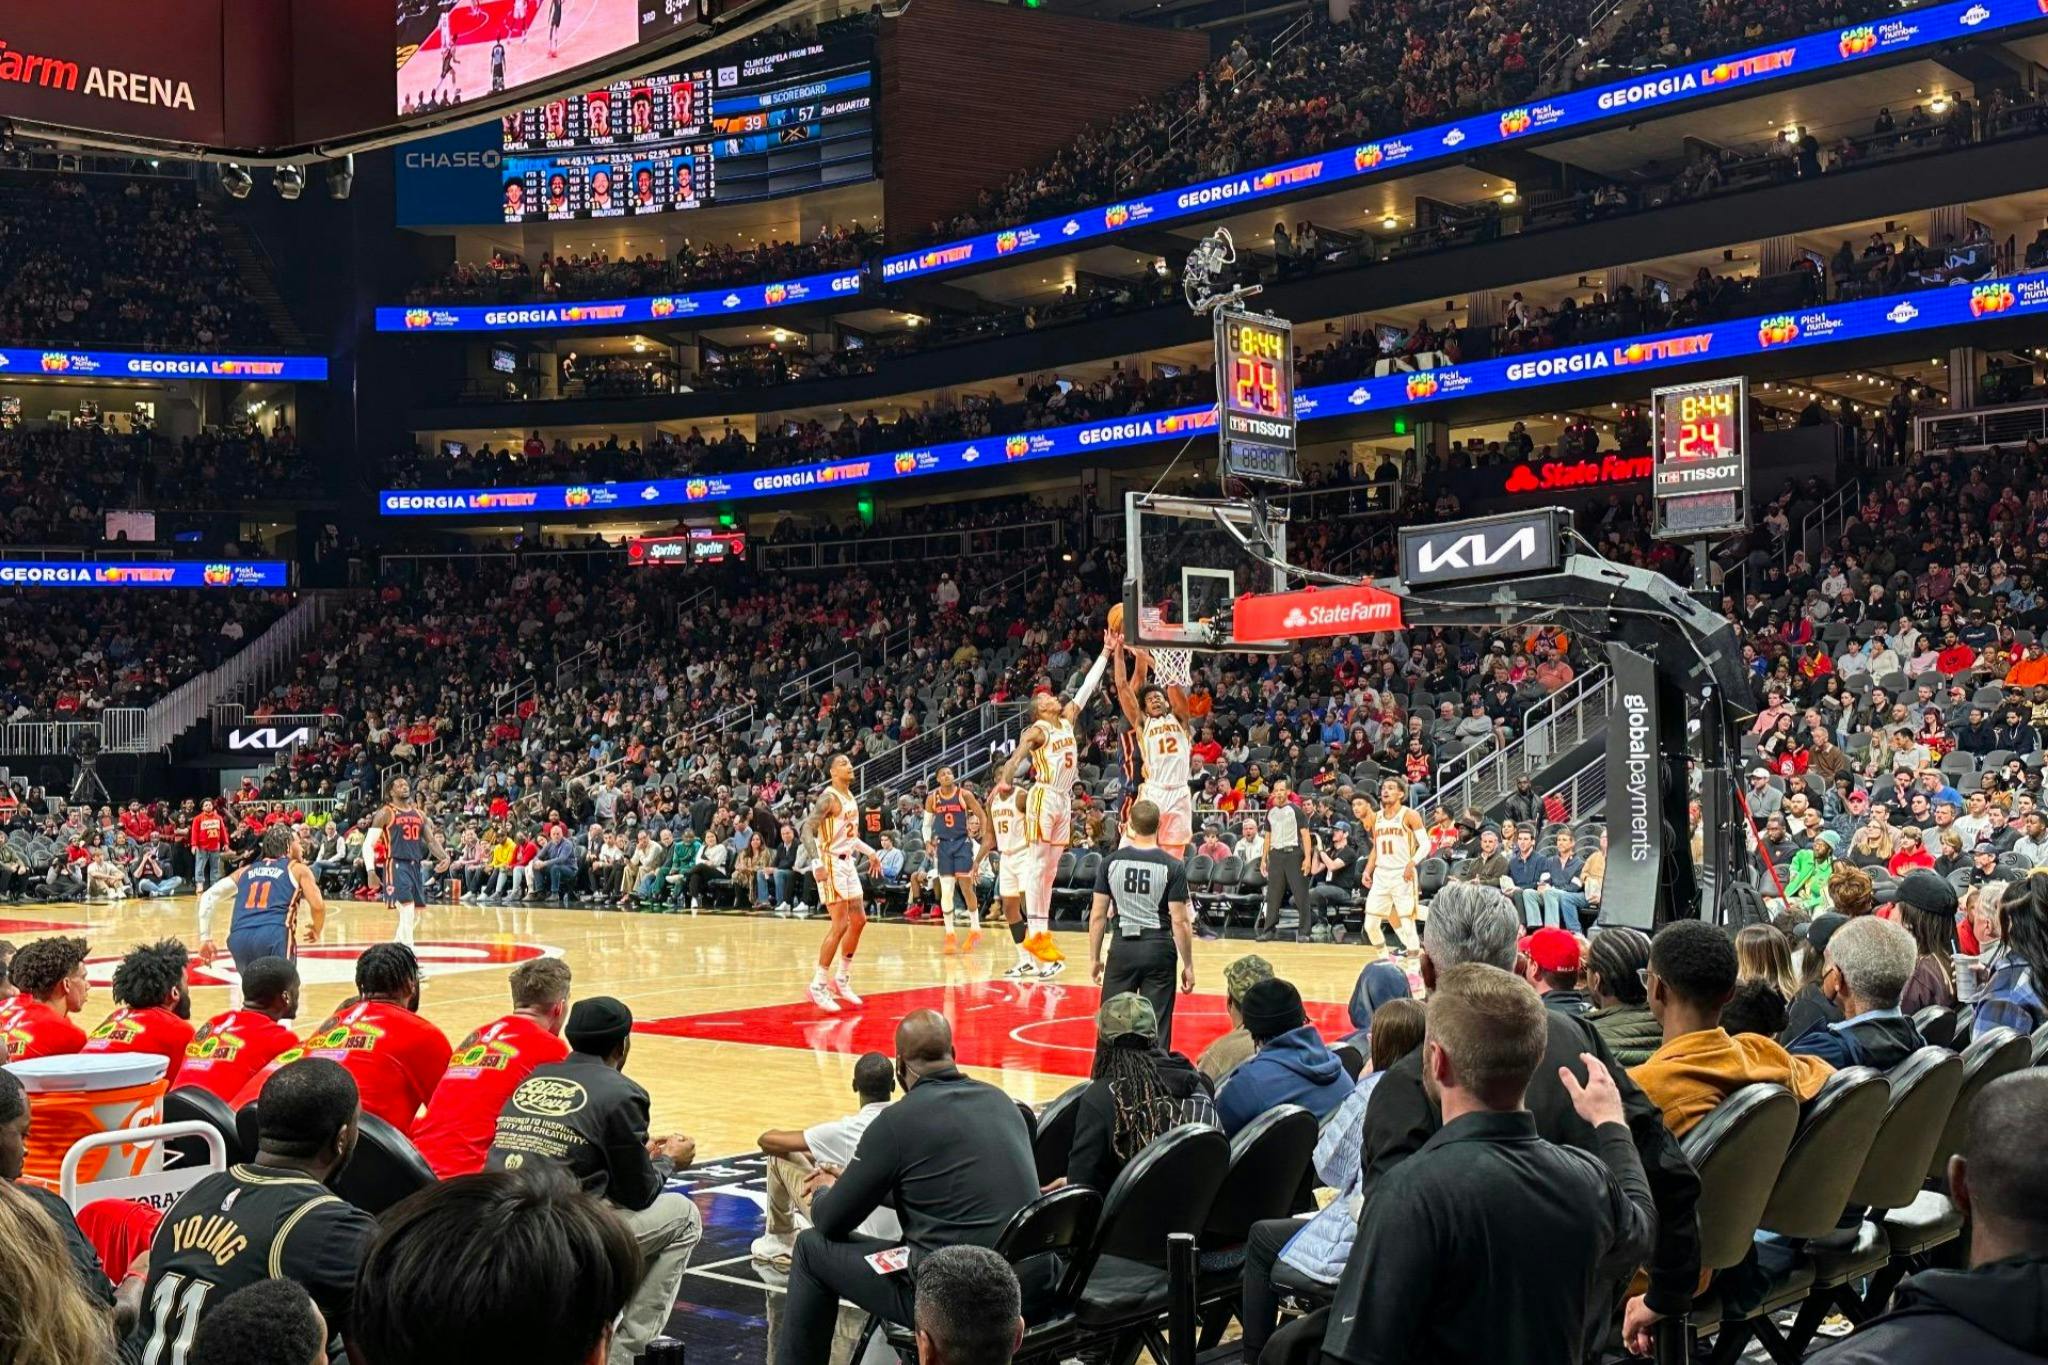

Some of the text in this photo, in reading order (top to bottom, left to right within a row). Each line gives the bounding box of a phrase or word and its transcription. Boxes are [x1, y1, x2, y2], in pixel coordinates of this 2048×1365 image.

[0, 40, 195, 111] arm ARENA
[720, 70, 735, 82] CC
[1598, 47, 1796, 109] GEORGIA LOTTERY
[773, 84, 827, 102] SCOREBOARD
[799, 106, 815, 121] 57
[821, 97, 870, 116] 2nd QUARTER
[744, 116, 762, 131] 39
[590, 136, 614, 144] YOUNG
[405, 152, 480, 168] CHASE
[1178, 161, 1323, 208] GEORGIA LOTTERY
[919, 245, 973, 269] LOTTERY
[485, 305, 626, 324] GEORGIA LOTTERY
[1970, 293, 2015, 318] POP
[1241, 327, 1282, 360] 8:44
[1758, 324, 1799, 347] POP
[1507, 333, 1713, 381] GEORGIA LOTTERY
[128, 359, 285, 375] GEORGIA LOTTERY
[1682, 394, 1733, 423] 8:44
[1079, 424, 1152, 445] GEORGIA
[1250, 420, 1292, 439] TISSOT
[1679, 422, 1721, 458] 24
[753, 471, 814, 491] GEORGIA
[816, 462, 870, 483] LOTTERY
[1541, 460, 1598, 488] State
[1680, 464, 1739, 482] TISSOT
[386, 493, 537, 509] GEORGIA LOTTERY
[650, 543, 682, 558] Sprite
[695, 541, 723, 556] Sprite
[1418, 526, 1536, 573] KIA
[0, 567, 175, 582] GEORGIA LOTTERY
[229, 727, 309, 749] KIA
[1158, 738, 1178, 754] 12
[1064, 754, 1073, 769] 5
[865, 814, 880, 832] 15
[944, 812, 955, 828] 9
[998, 821, 1009, 834] 15
[402, 824, 419, 841] 30
[1382, 841, 1394, 855] 11
[1124, 867, 1151, 894] 86
[244, 881, 271, 909] 11
[173, 1214, 248, 1266] YOUNG
[141, 1271, 216, 1365] 11
